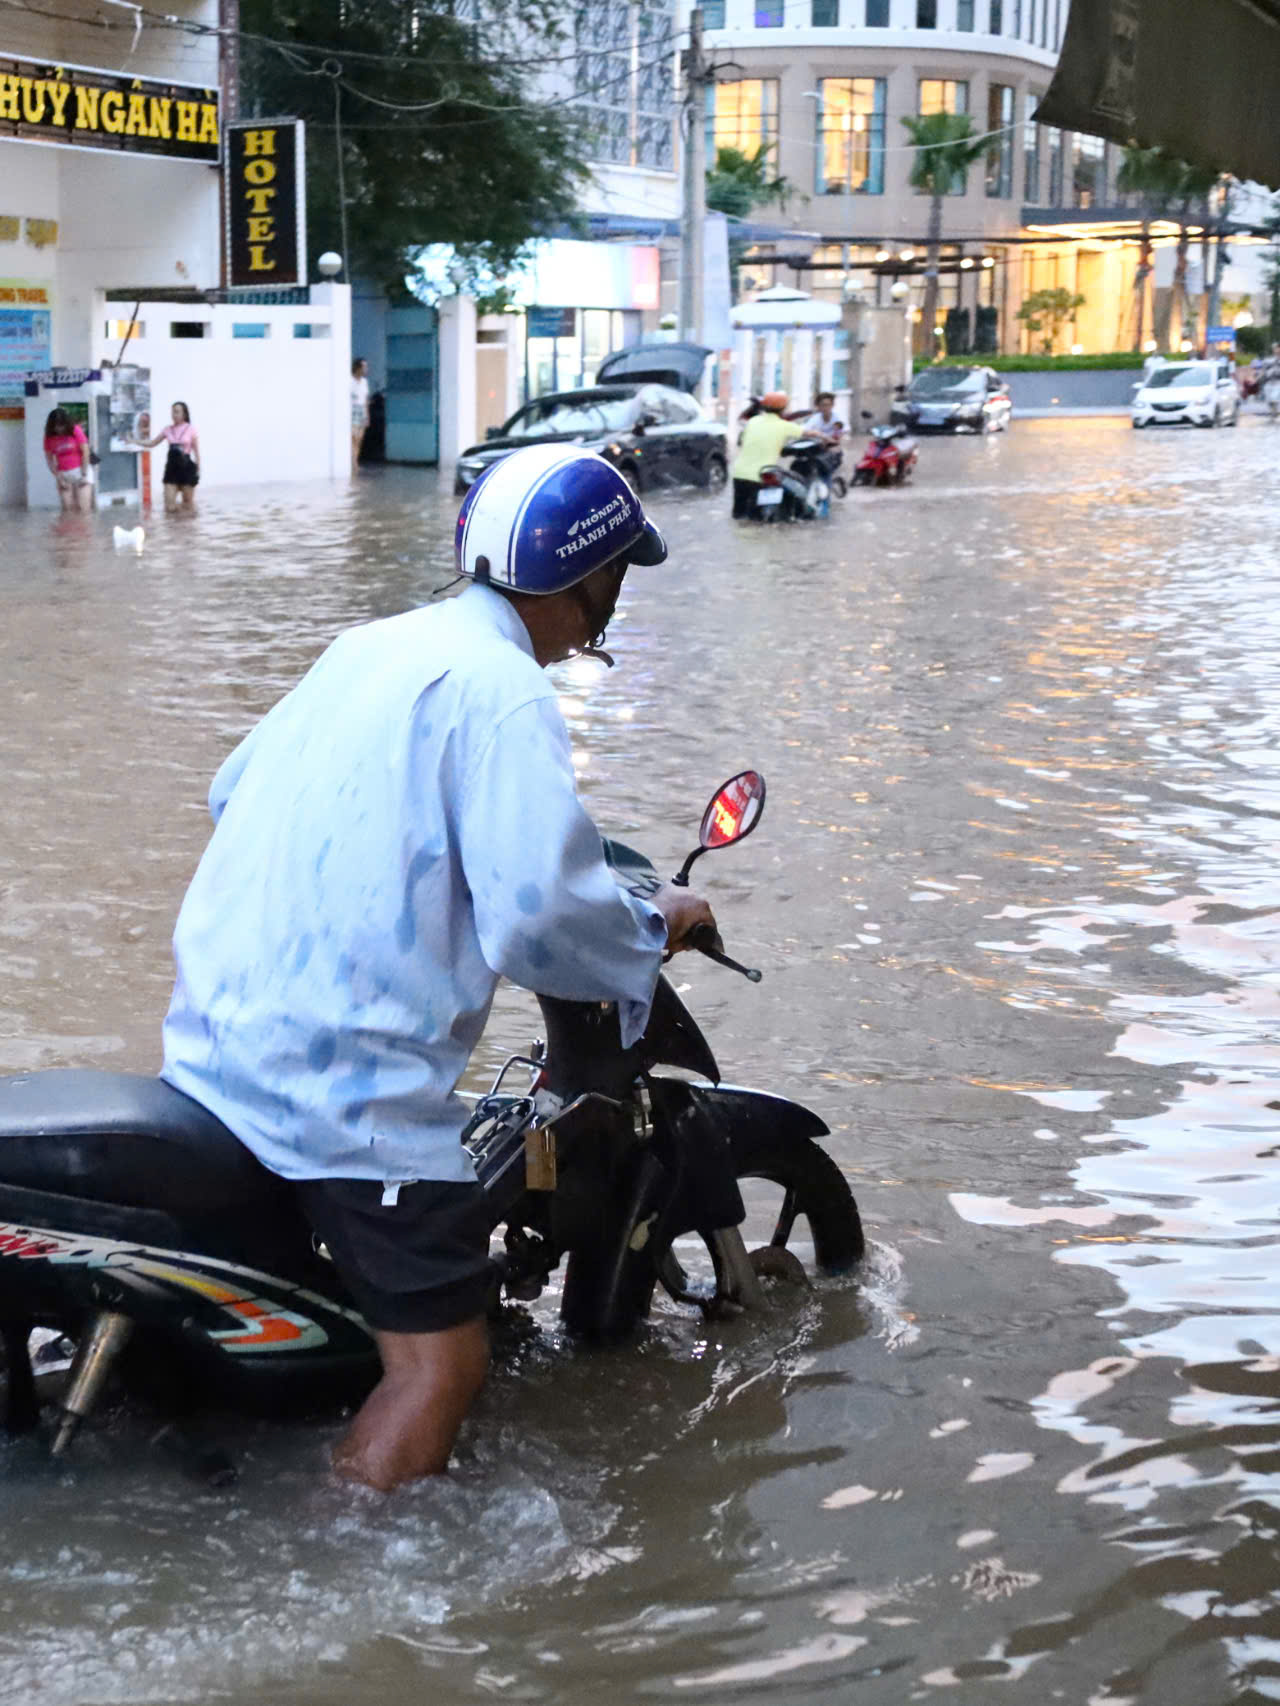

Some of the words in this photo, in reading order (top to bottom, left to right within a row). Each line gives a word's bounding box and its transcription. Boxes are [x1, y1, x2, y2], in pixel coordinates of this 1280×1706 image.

[75, 79, 171, 138] NGÂN
[243, 129, 277, 271] HOTEL
[580, 498, 621, 529] HONDA
[556, 524, 607, 559] THÀNH
